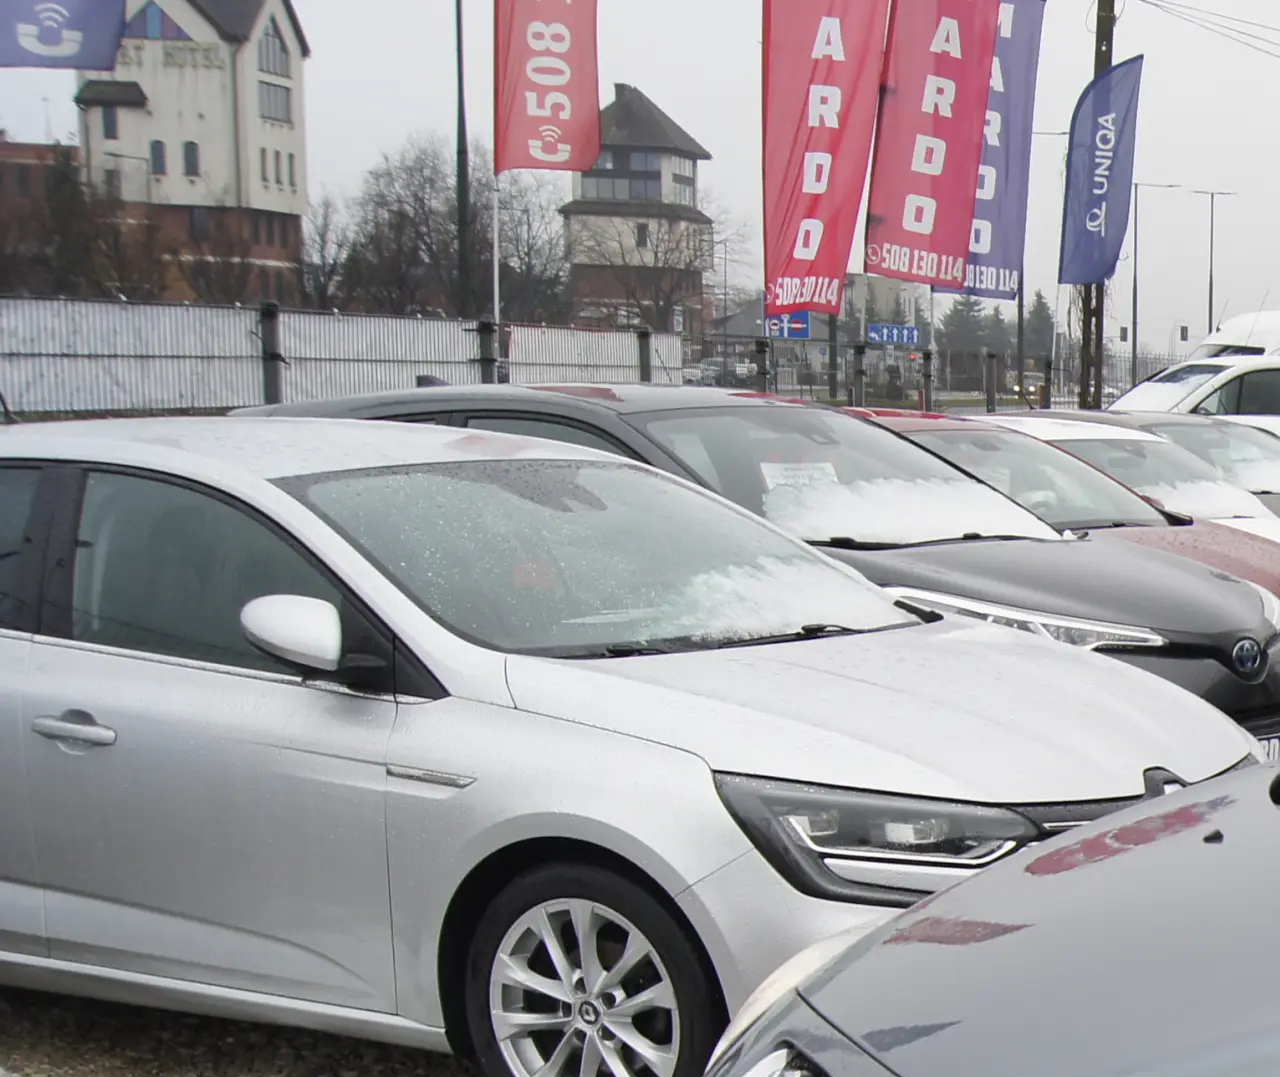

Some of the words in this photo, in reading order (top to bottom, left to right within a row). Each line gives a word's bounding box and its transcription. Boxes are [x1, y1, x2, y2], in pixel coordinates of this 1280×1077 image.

[525, 21, 571, 120] 508
[1093, 112, 1116, 195] UNIQA
[881, 242, 910, 272] 508
[911, 249, 938, 277] 130
[939, 255, 964, 282] 114
[999, 268, 1018, 292] 114
